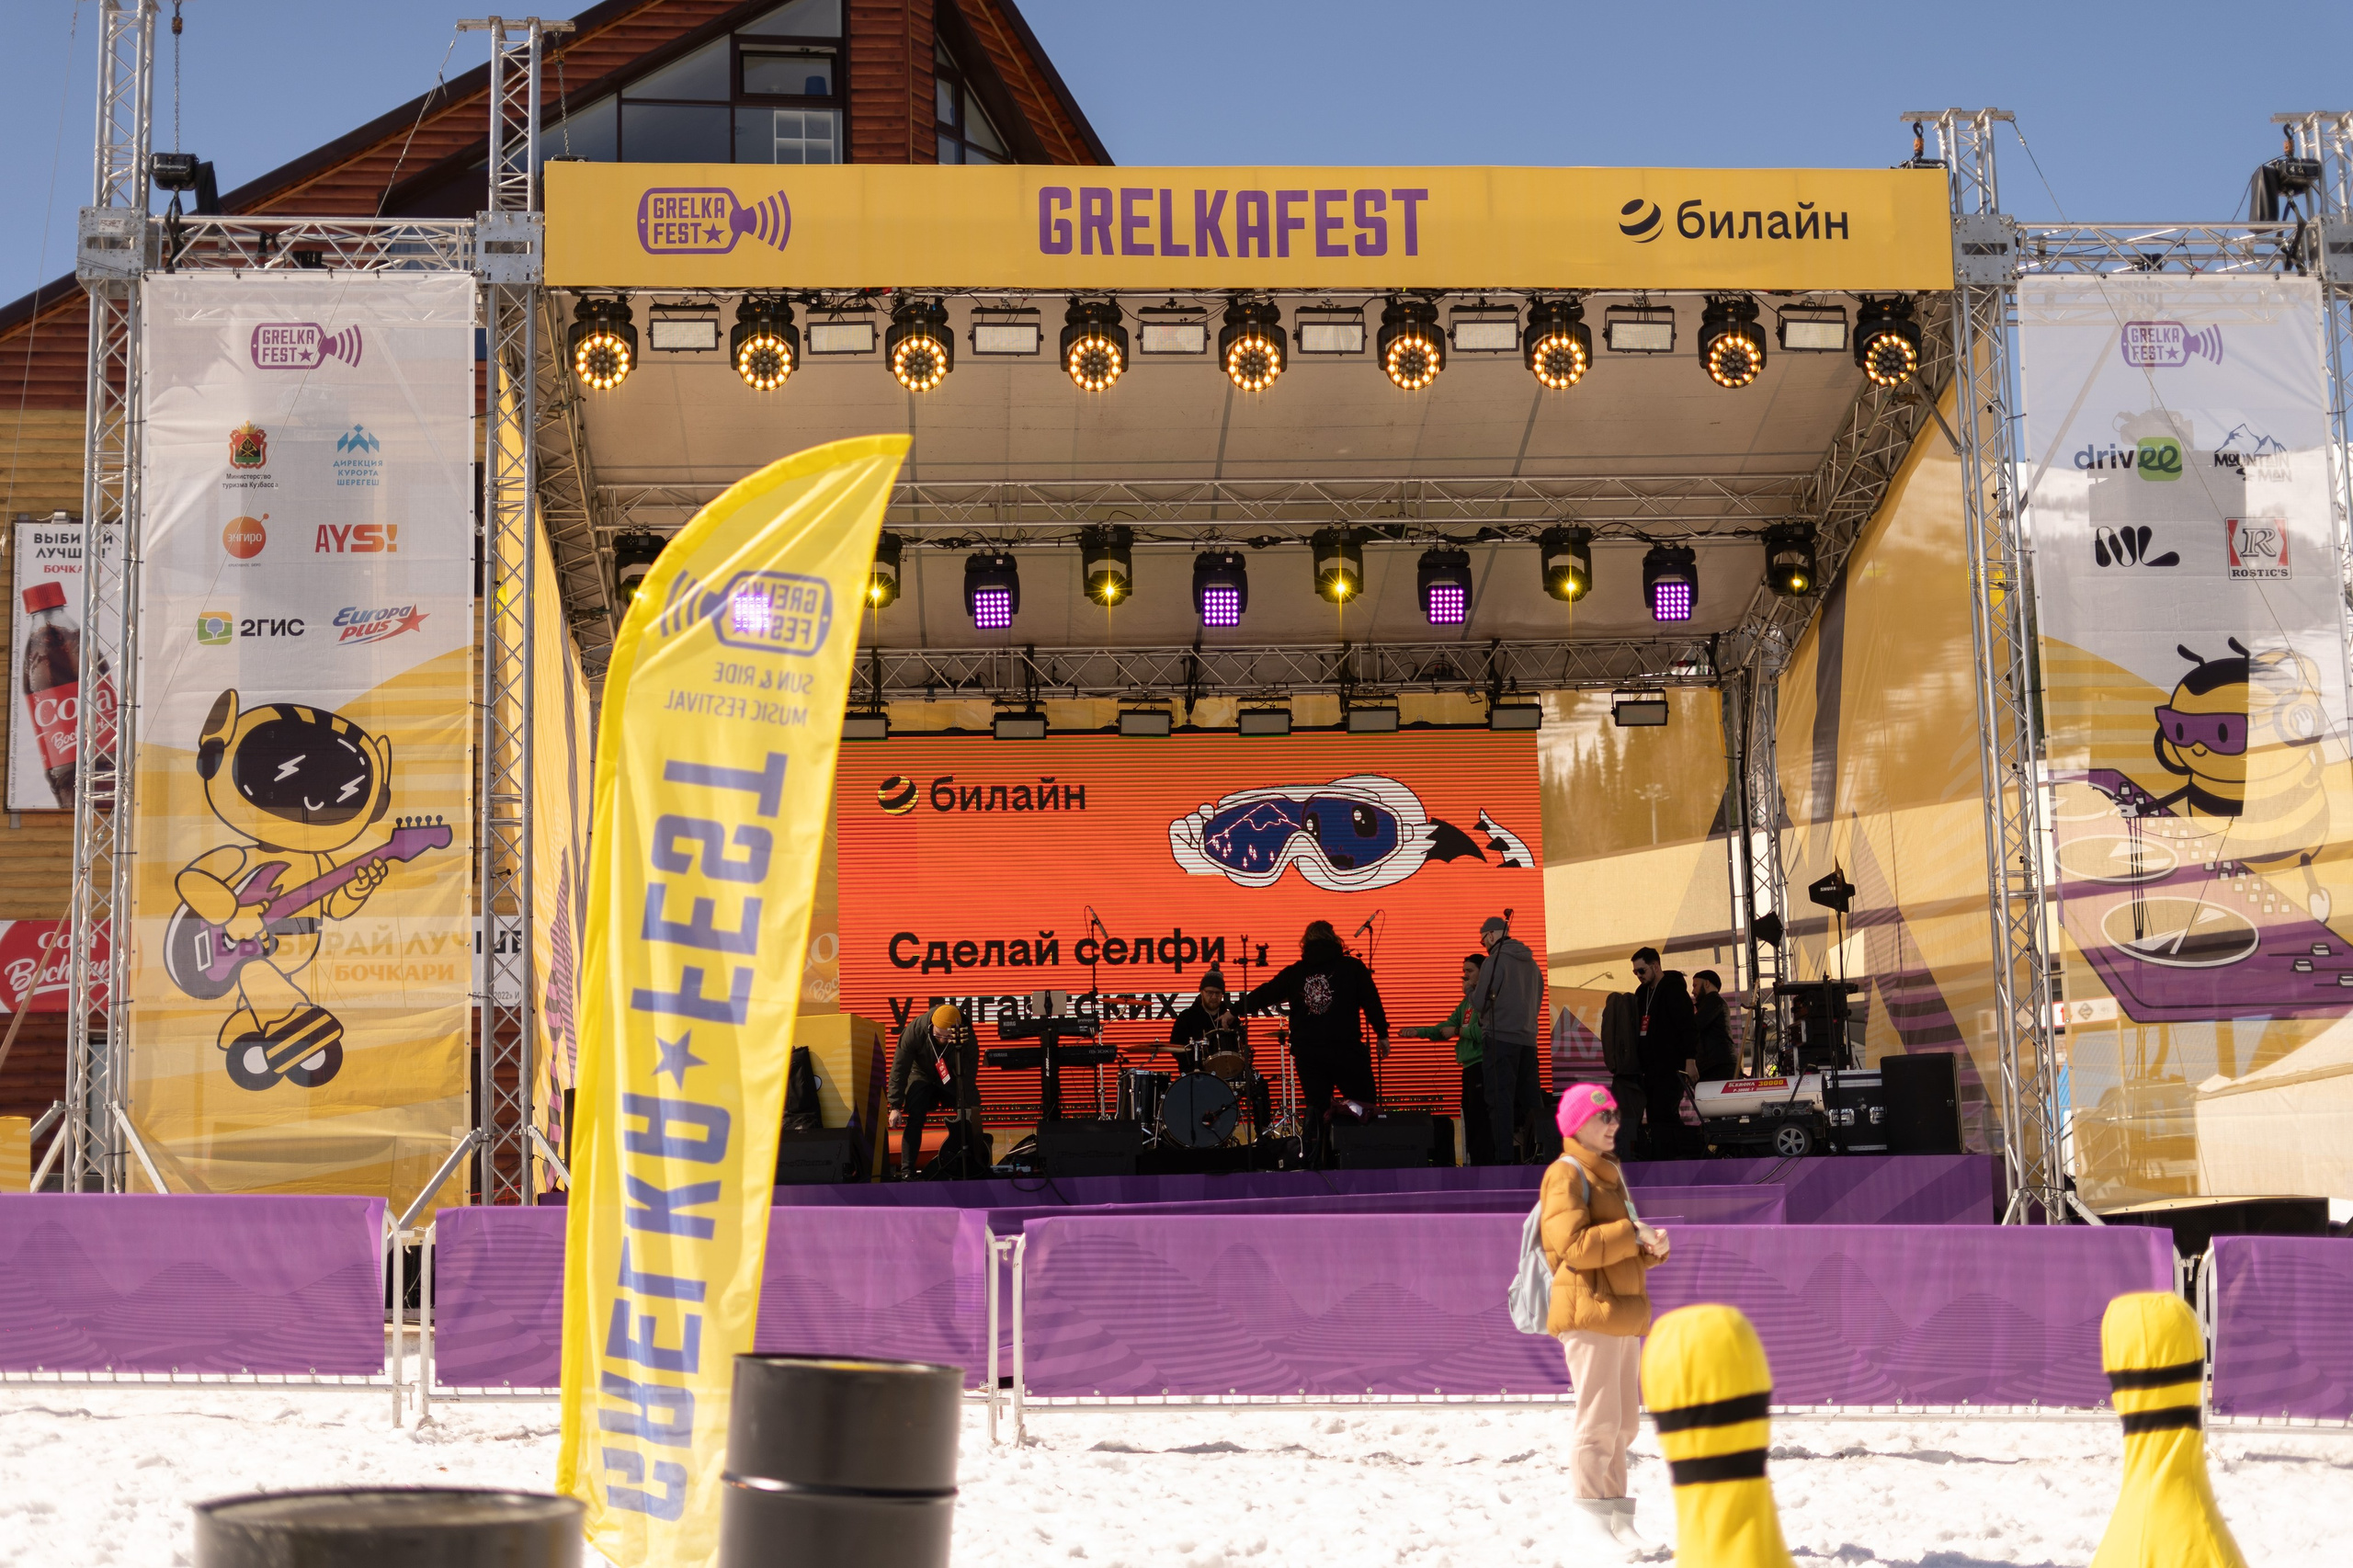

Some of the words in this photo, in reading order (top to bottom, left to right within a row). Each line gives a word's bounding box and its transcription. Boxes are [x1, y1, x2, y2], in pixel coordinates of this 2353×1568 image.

[652, 197, 726, 221] GRELKA
[1676, 198, 1849, 240] билайн
[654, 222, 701, 244] FEST
[1039, 187, 1428, 258] GRELKAFEST
[262, 329, 315, 346] GRELKA
[2131, 327, 2180, 344] GRELKA
[262, 347, 298, 363] FEST
[2131, 346, 2165, 360] FEST
[2074, 444, 2183, 473] drivee
[222, 482, 248, 490] туризма
[226, 472, 271, 481] Министерство
[227, 532, 263, 545] энгиро
[314, 524, 398, 552] AYS!
[2232, 568, 2289, 577] ROSTIC'S
[332, 606, 413, 627] Europa
[240, 618, 305, 637] 2ГИС
[35, 688, 113, 727] Coa
[928, 776, 1086, 812] билайн
[888, 929, 1060, 974] Сделай
[1074, 927, 1225, 974] селфи
[335, 963, 455, 982] БОЧКАРИ
[889, 997, 913, 1035] у
